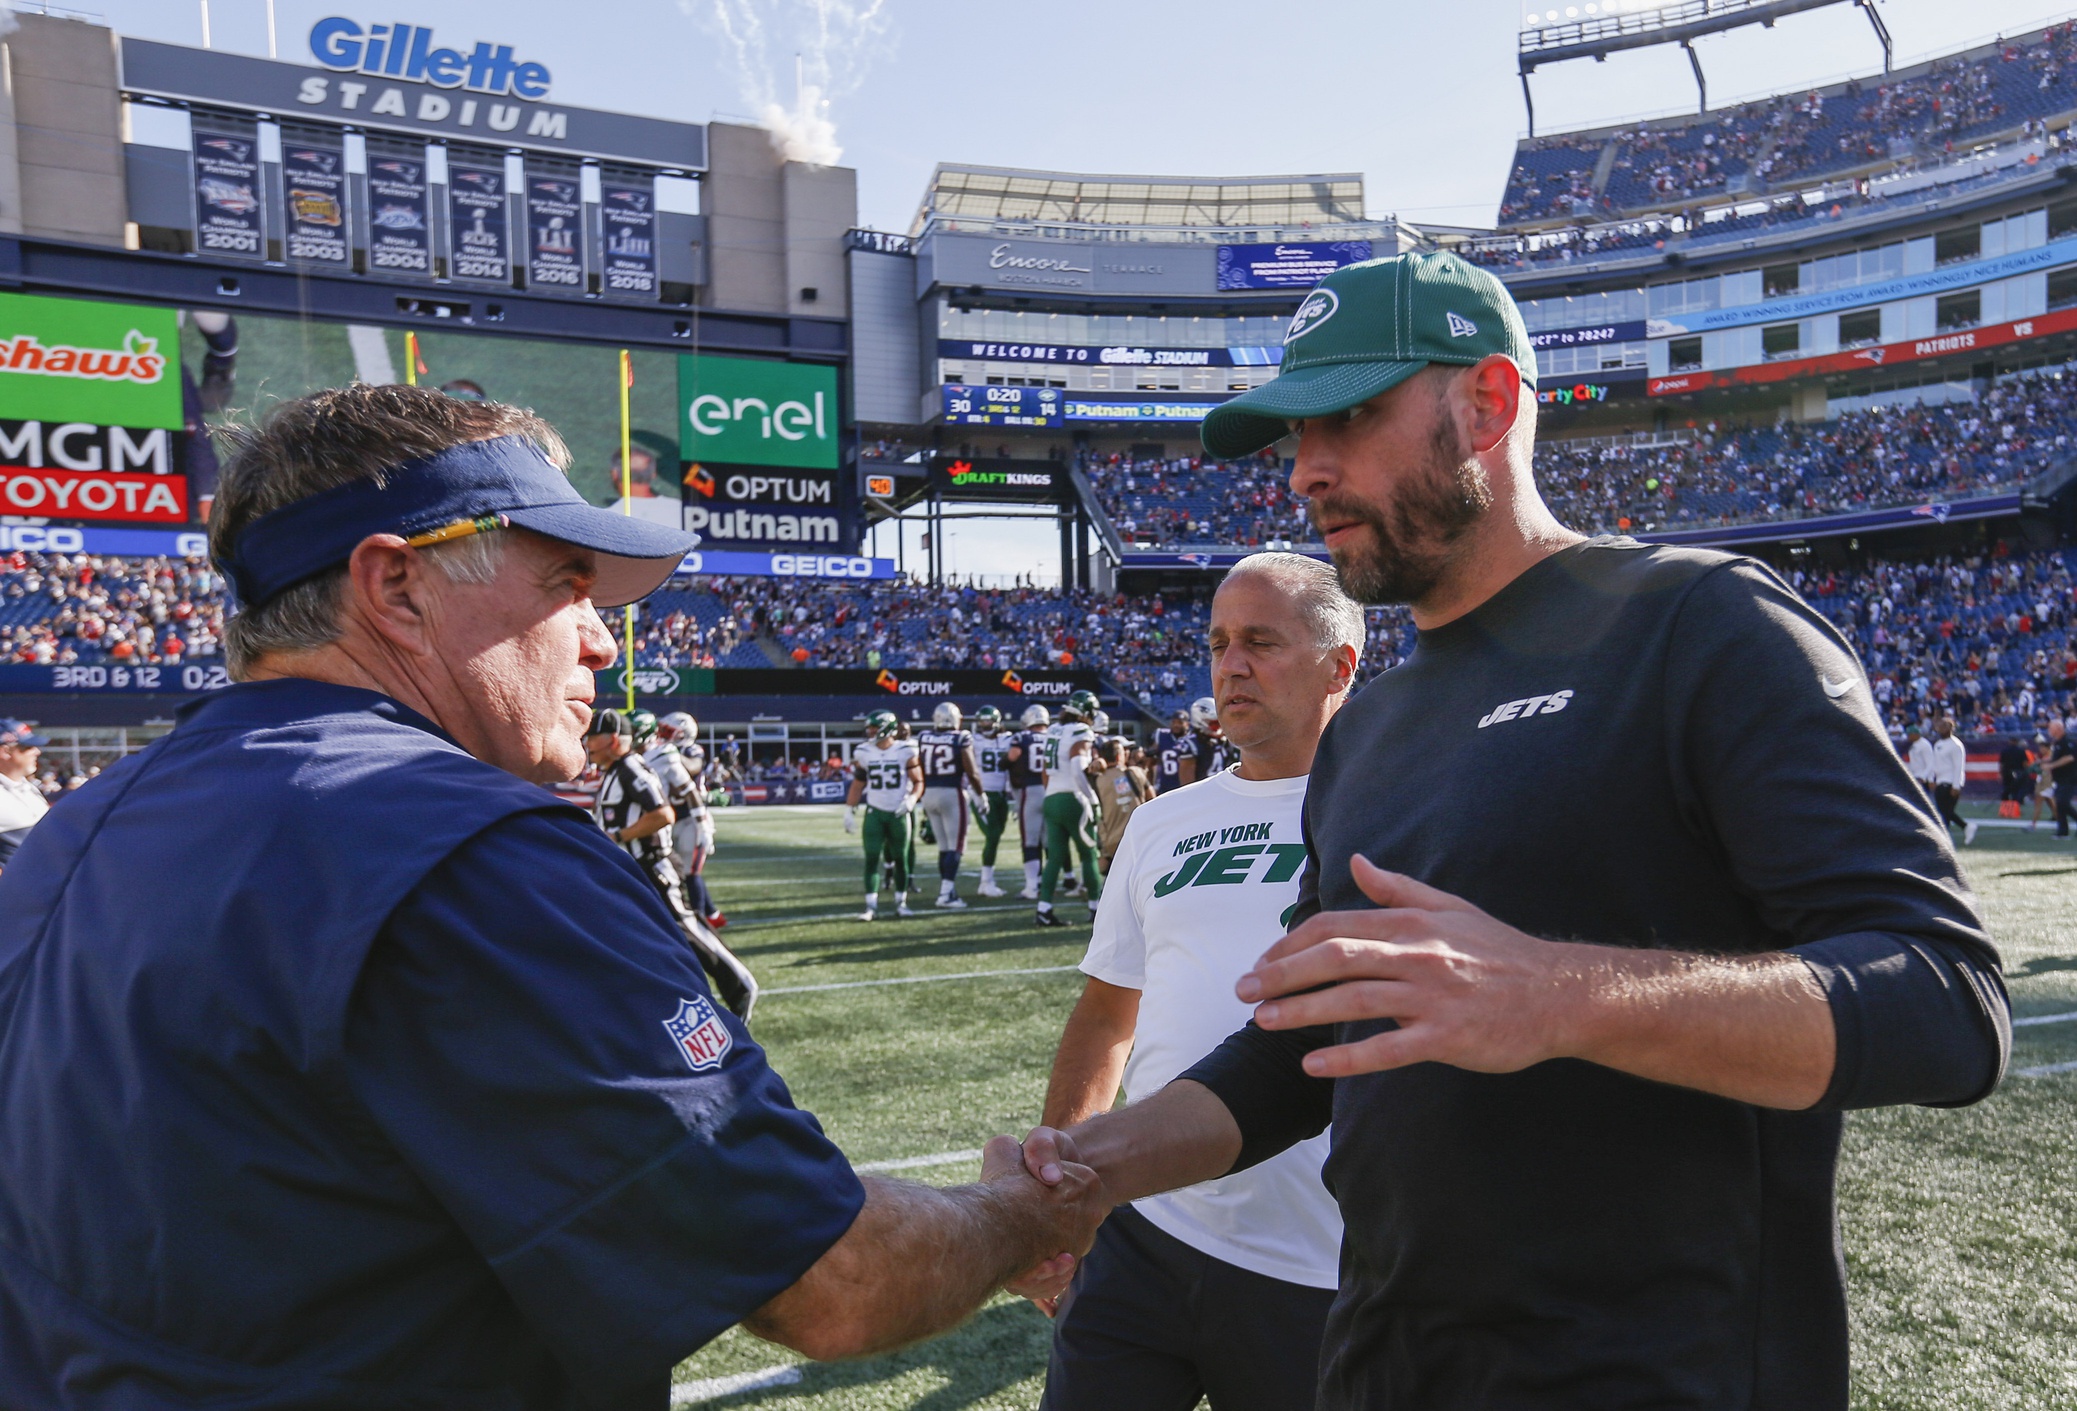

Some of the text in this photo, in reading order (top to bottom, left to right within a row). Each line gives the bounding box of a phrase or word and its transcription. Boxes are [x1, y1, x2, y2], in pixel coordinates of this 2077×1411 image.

[309, 16, 551, 98] Gillette
[298, 77, 568, 140] STADIUM
[204, 233, 257, 251] 2001
[290, 243, 345, 261] 2003
[375, 252, 427, 270] 2004
[457, 261, 504, 278] 2014
[989, 243, 1091, 273] Encore
[535, 268, 579, 285] 2016
[610, 275, 652, 291] 2018
[1562, 333, 1574, 343] to
[1578, 328, 1615, 341] 78247
[1915, 322, 2034, 355] PATRIOTS VS
[971, 344, 1209, 365] WELCOME TO Gillette STADIUM
[950, 399, 972, 413] 30
[1040, 403, 1057, 416] 14
[986, 388, 1022, 403] 0:20
[689, 391, 828, 441] enel
[1076, 405, 1139, 417] Putnam
[0, 475, 181, 515] OYOTA
[726, 475, 831, 503] OPTUM
[683, 506, 840, 542] Putnam
[771, 554, 873, 578] GEICO
[53, 666, 232, 690] 3RD & 12 0:2
[898, 681, 950, 695] OPTUM
[1022, 682, 1071, 695] OPTUM
[1477, 690, 1575, 729] JETS
[921, 744, 957, 775] 72
[1028, 743, 1044, 773] 6
[868, 764, 901, 790] 53
[1172, 822, 1274, 857] NEW YORK
[1153, 843, 1308, 899] JET
[684, 1021, 727, 1064] NFL
